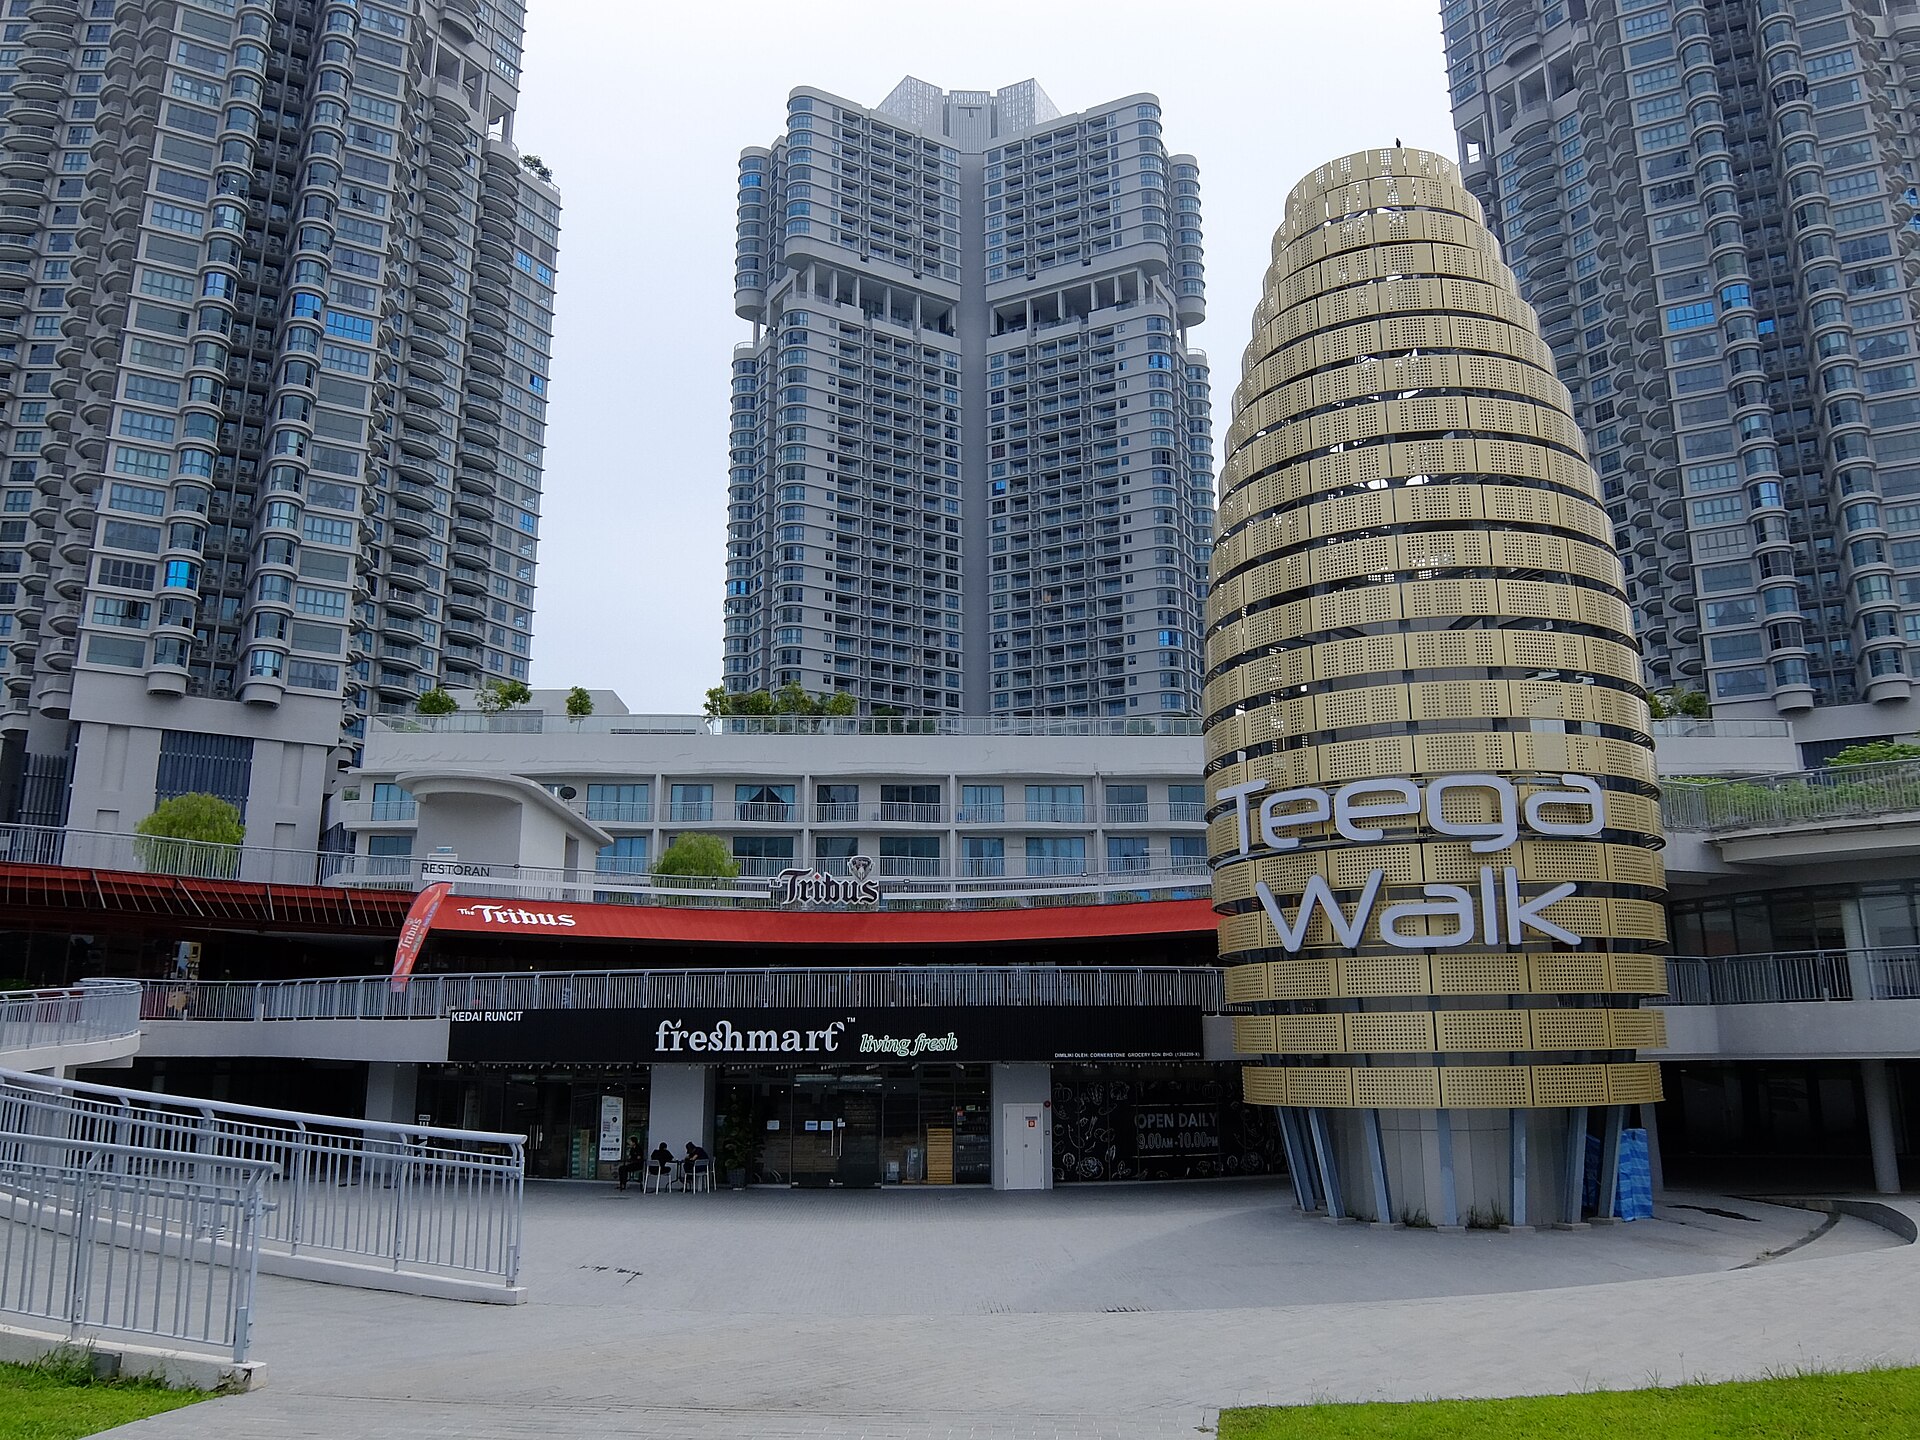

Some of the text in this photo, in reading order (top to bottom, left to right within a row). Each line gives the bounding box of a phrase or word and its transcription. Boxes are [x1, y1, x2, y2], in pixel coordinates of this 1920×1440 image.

[1216, 774, 1605, 854] Teega
[421, 862, 490, 877] RESTORAN
[778, 867, 880, 904] Tribus
[457, 904, 577, 927] The Tribus
[1255, 866, 1582, 952] Walk
[451, 1011, 523, 1022] KEDAI RUNCIT
[655, 1019, 845, 1052] freshmart
[860, 1032, 958, 1057] living fresh
[1134, 1112, 1217, 1129] OPEN DAILY
